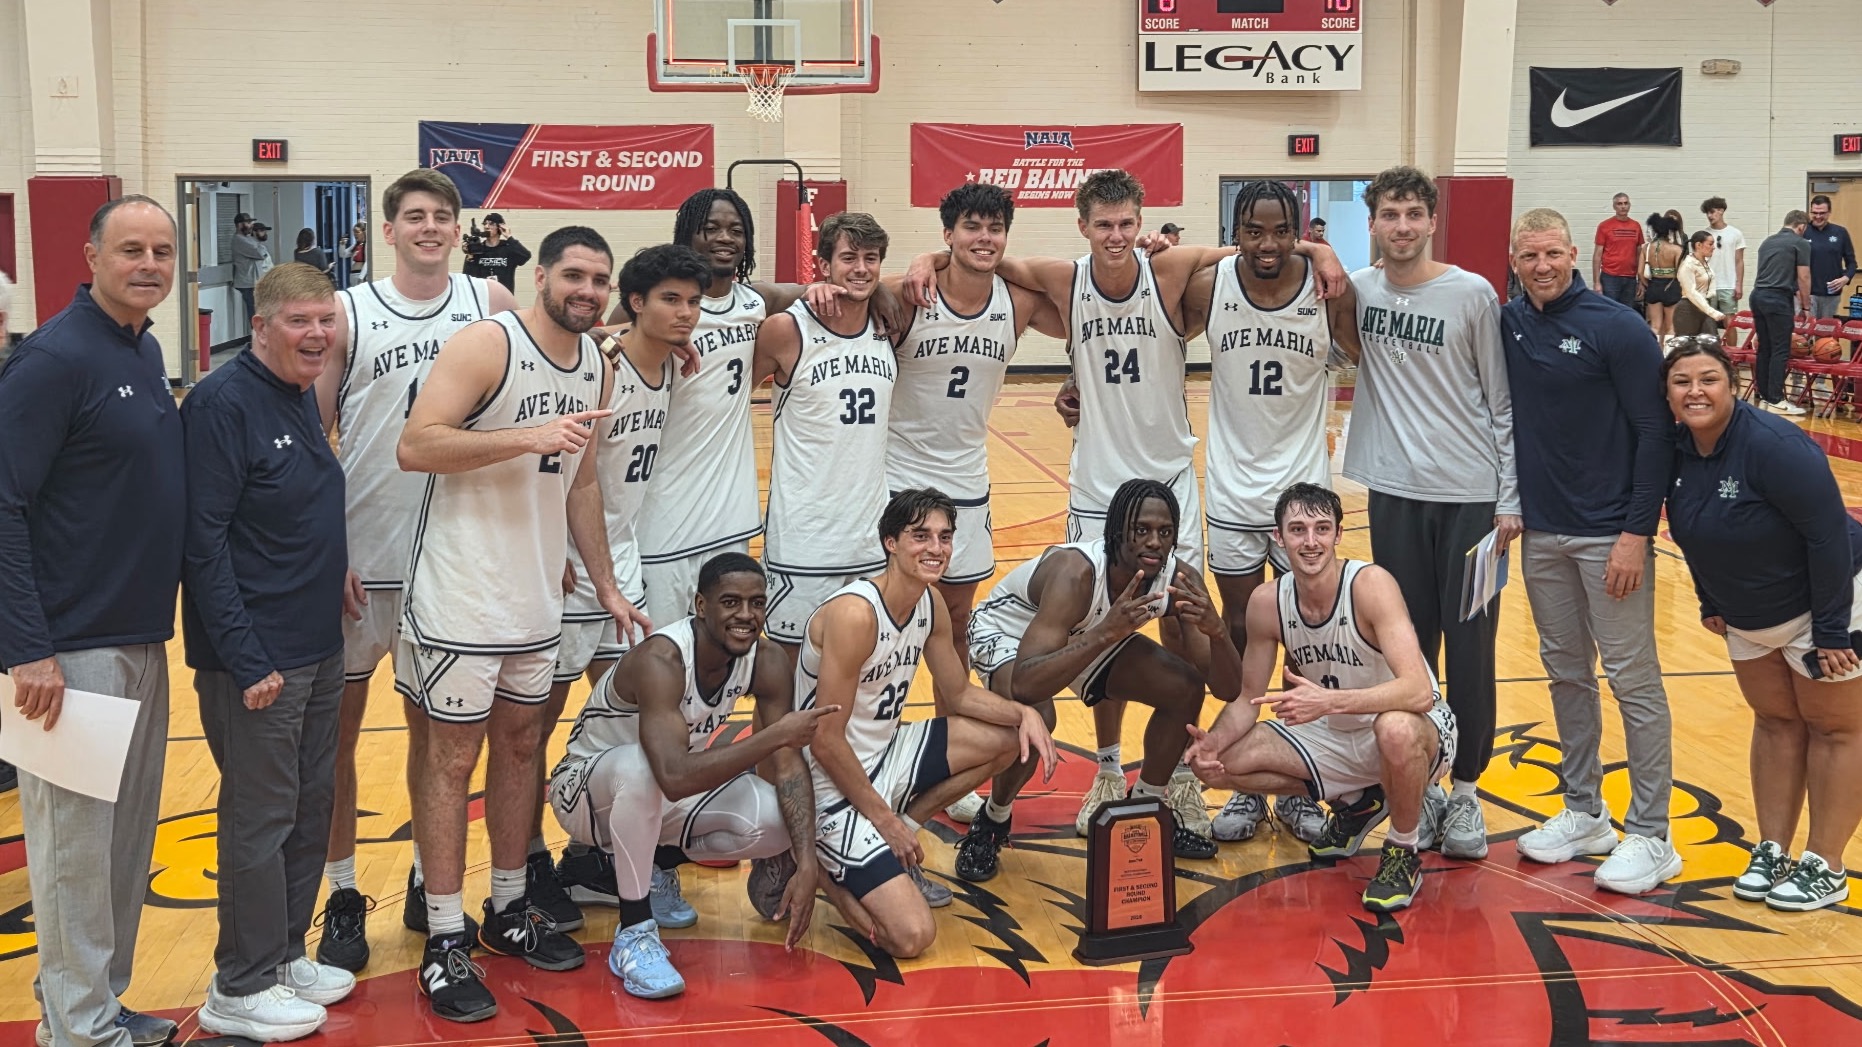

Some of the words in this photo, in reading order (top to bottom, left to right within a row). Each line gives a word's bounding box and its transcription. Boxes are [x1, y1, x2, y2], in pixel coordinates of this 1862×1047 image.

[1145, 18, 1180, 29] SCORE
[1231, 18, 1269, 29] MATCH
[1321, 18, 1356, 29] SCORE
[1145, 40, 1355, 77] LEGACY
[1266, 72, 1321, 84] Bank
[258, 142, 282, 159] EXIT
[1024, 131, 1075, 150] NAIA
[1295, 137, 1315, 153] EXIT
[1842, 136, 1861, 152] EXIT
[430, 148, 486, 173] NAIA
[531, 151, 592, 168] FIRST
[595, 151, 613, 168] &
[616, 151, 703, 168] SECOND
[1012, 158, 1047, 167] BATTLE
[1048, 158, 1065, 167] FOR
[1066, 158, 1085, 167] THE
[580, 175, 656, 192] ROUND
[977, 168, 1022, 189] RED
[1024, 168, 1117, 189] BANN
[1017, 190, 1051, 200] BEGINS
[1052, 190, 1076, 200] NOW
[1361, 305, 1388, 335] AVE
[1388, 310, 1445, 347] MARIA
[693, 331, 718, 357] VE
[913, 336, 950, 359] AVE
[953, 335, 1006, 363] MARIA
[1220, 328, 1252, 353] AVE
[1255, 328, 1315, 358] MARIA
[1362, 332, 1440, 355] BASKETBALL
[373, 344, 409, 380] AVE
[810, 356, 841, 387] AVE
[844, 354, 894, 383] MARIA
[1104, 347, 1141, 384] 24
[727, 358, 744, 395] 3
[946, 365, 970, 399] 2
[1248, 359, 1283, 396] 12
[515, 391, 551, 423] AVE
[839, 387, 876, 425] 32
[607, 410, 643, 440] AVE
[624, 443, 659, 483] 20
[861, 654, 892, 684] AVE
[873, 680, 910, 721] 22
[1126, 890, 1146, 898] ROUND
[1135, 882, 1158, 890] SECOND
[1121, 896, 1151, 904] CHAMPION
